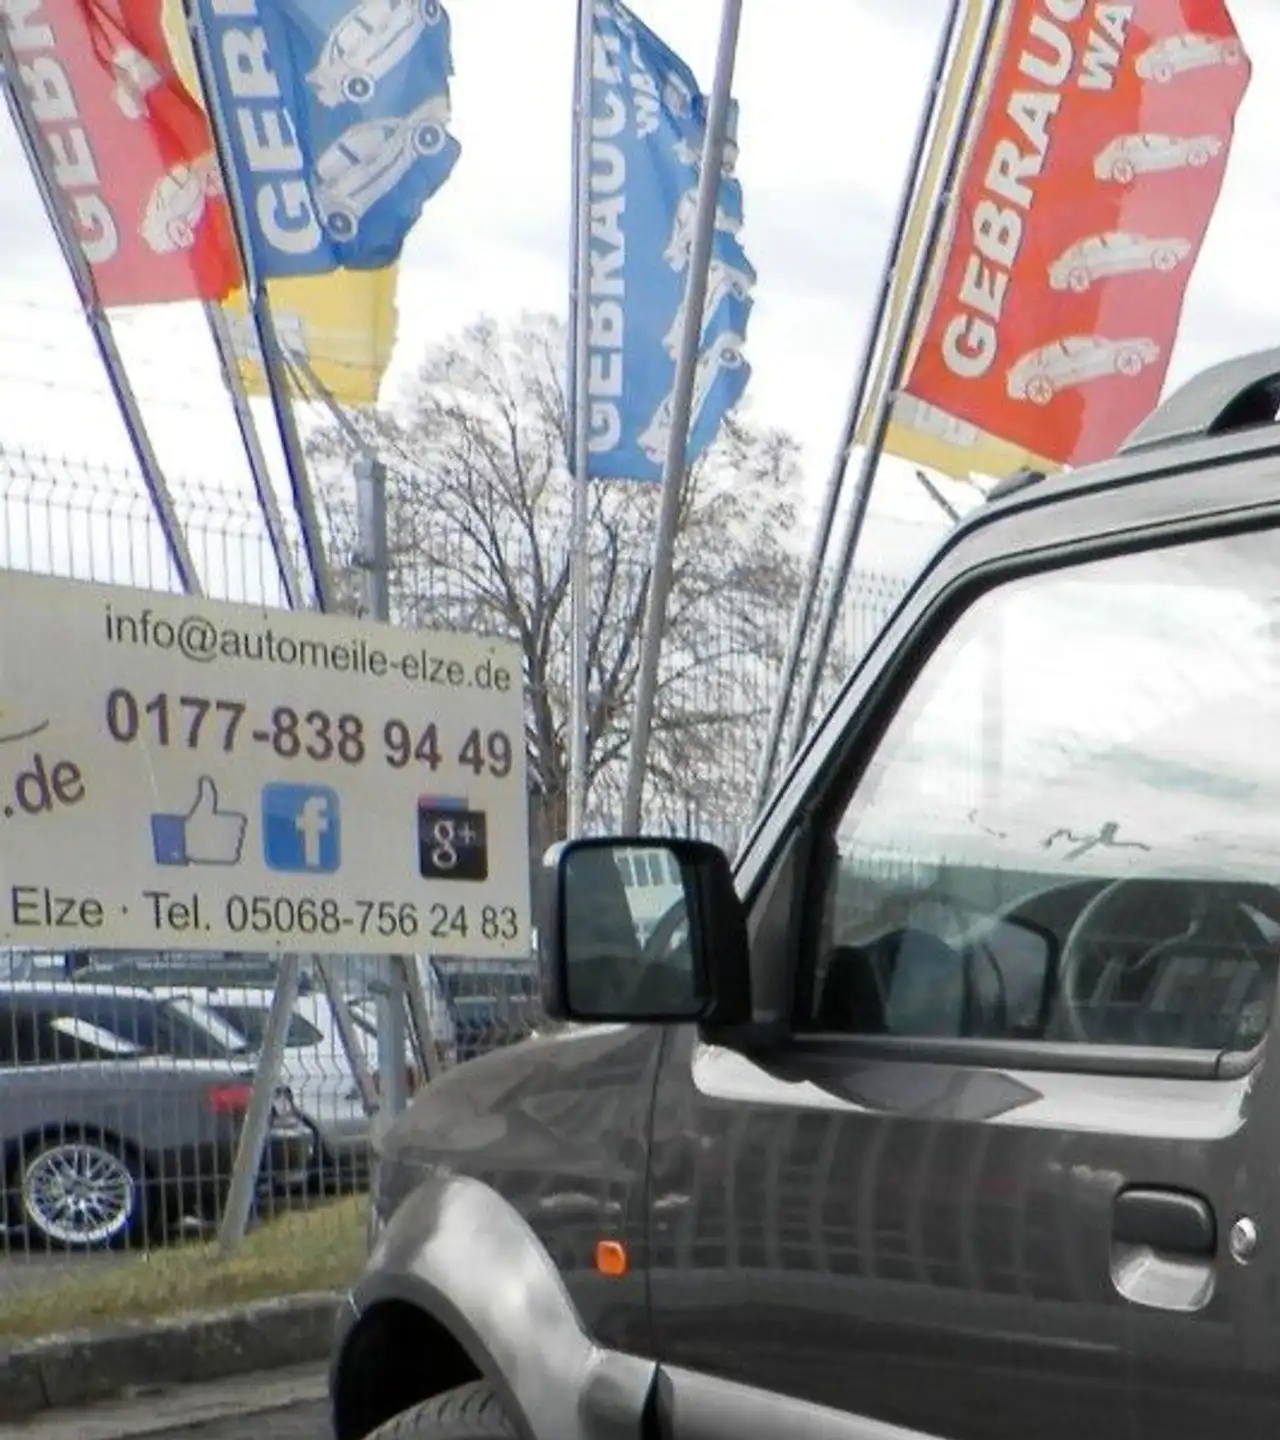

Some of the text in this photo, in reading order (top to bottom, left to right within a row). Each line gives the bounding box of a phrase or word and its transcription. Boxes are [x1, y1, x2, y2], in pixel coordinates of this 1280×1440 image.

[105, 605, 511, 693] info@automeile-elze.de
[105, 687, 512, 778] 0177-838 94 49
[11, 886, 519, 941] Elze Tel. 05068-756 24 83
